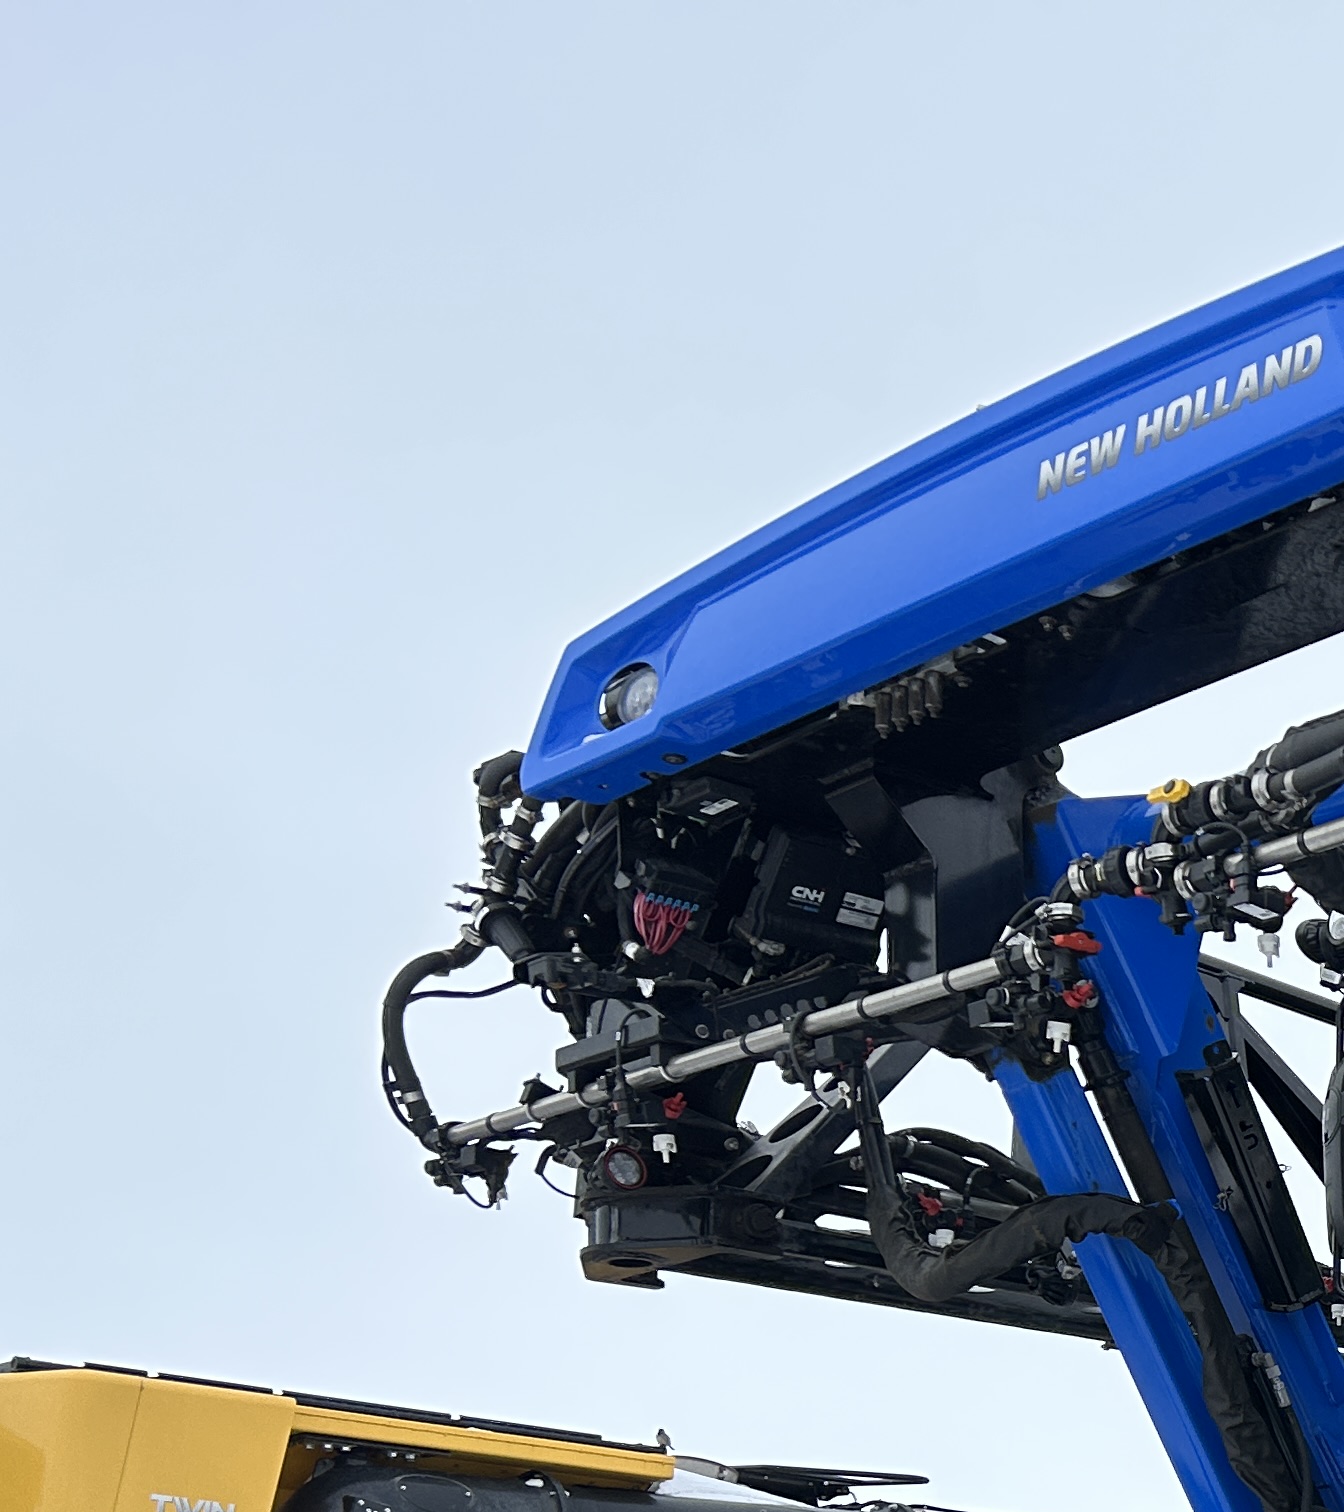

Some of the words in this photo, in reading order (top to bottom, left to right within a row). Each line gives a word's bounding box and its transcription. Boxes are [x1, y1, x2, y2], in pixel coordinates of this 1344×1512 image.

[1037, 423, 1126, 501] NEW
[1134, 333, 1324, 456] HOLLAND
[791, 885, 825, 903] CNH
